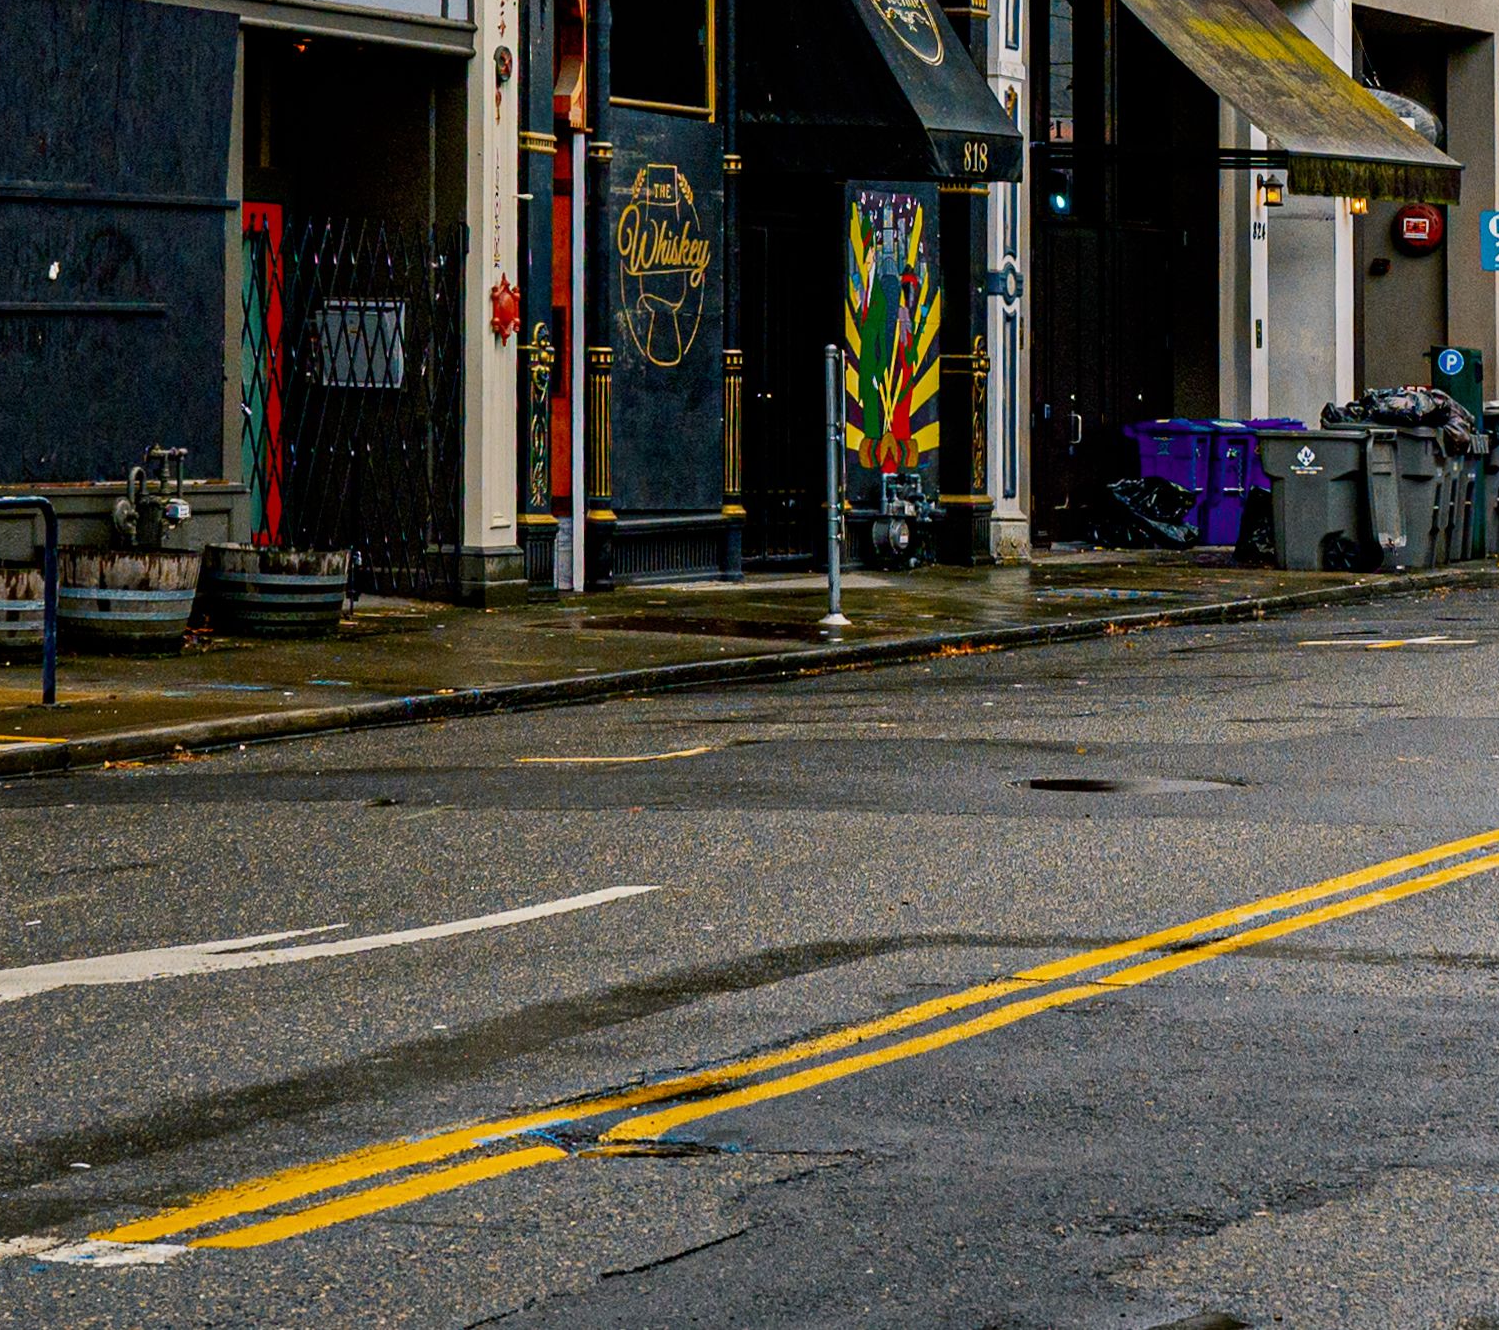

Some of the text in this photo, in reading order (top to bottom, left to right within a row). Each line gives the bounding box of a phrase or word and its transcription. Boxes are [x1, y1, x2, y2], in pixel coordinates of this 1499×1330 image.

[964, 141, 988, 173] 818
[653, 183, 672, 199] THE
[1252, 221, 1266, 241] 824
[617, 204, 711, 288] Whiskey
[1446, 354, 1458, 371] P
